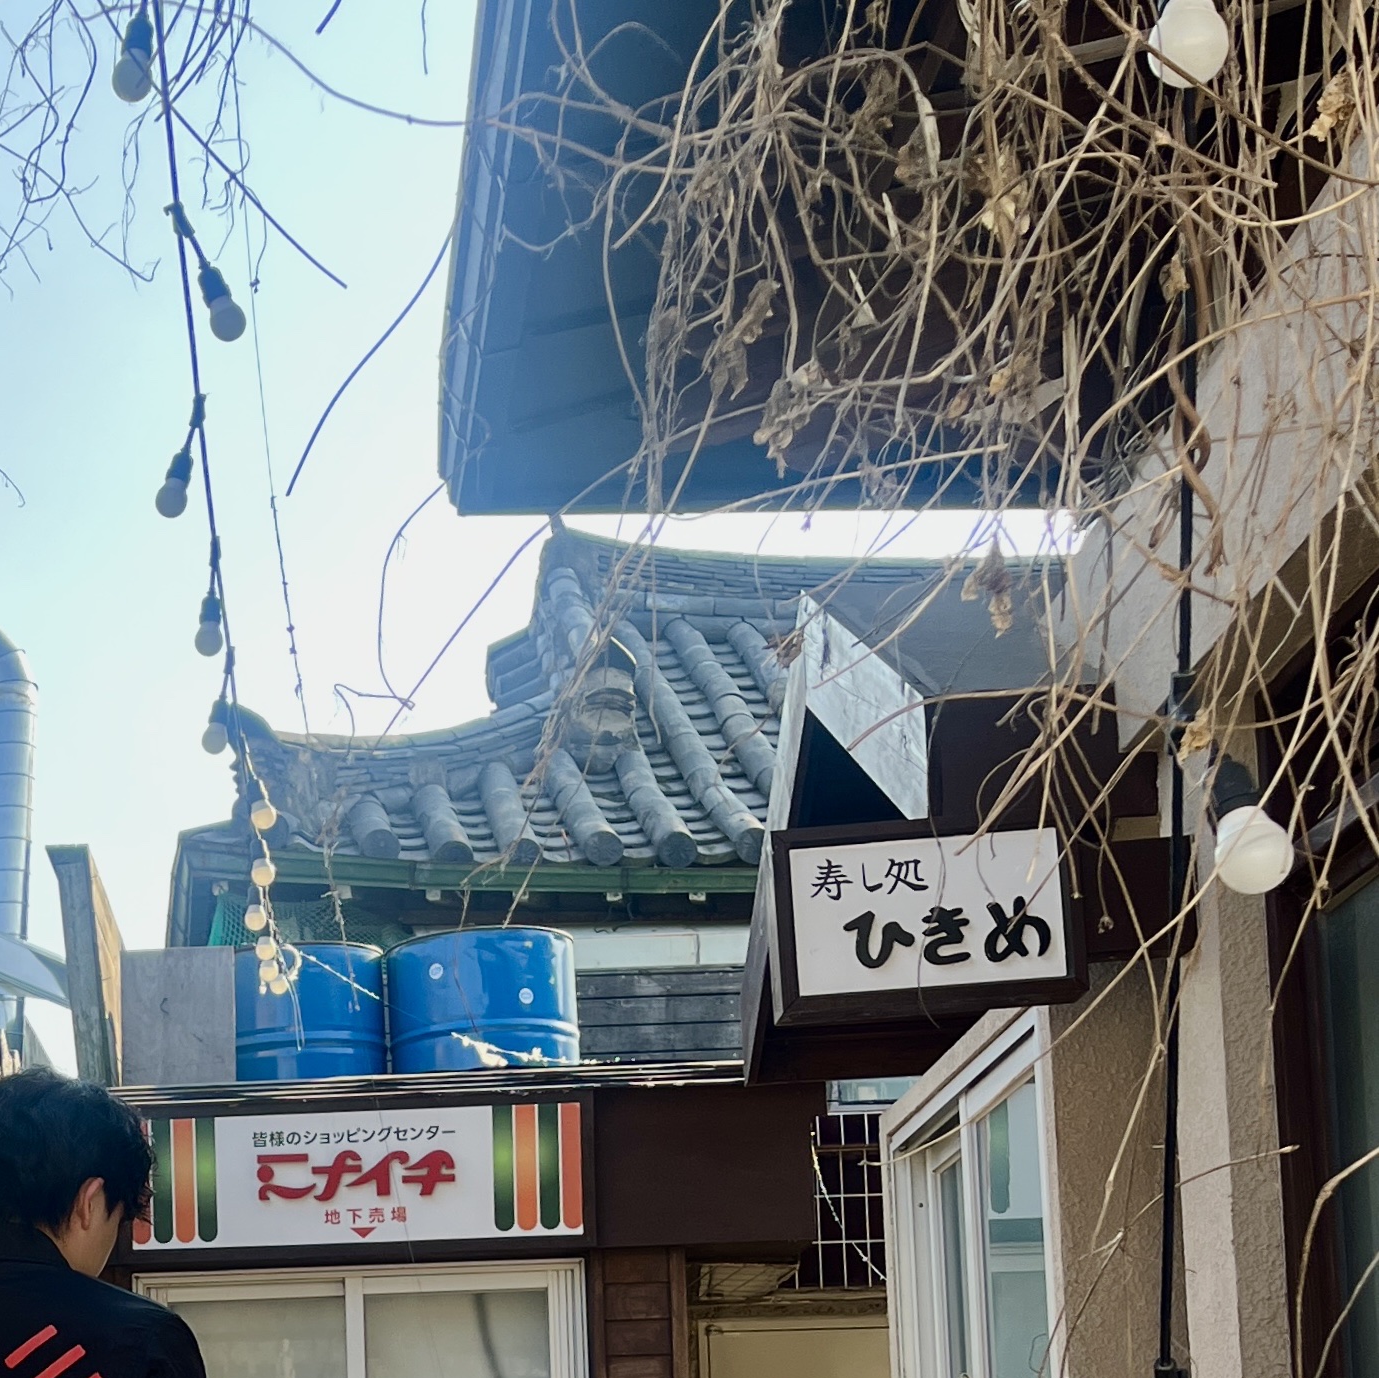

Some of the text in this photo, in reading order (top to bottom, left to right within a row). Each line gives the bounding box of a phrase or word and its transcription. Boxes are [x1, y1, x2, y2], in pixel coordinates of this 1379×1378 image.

[811, 858, 929, 900] 寿し処
[843, 896, 1051, 969] ひきめ
[252, 1125, 456, 1148] 皆様のショッピングセンター
[324, 1206, 407, 1224] 地下売場
